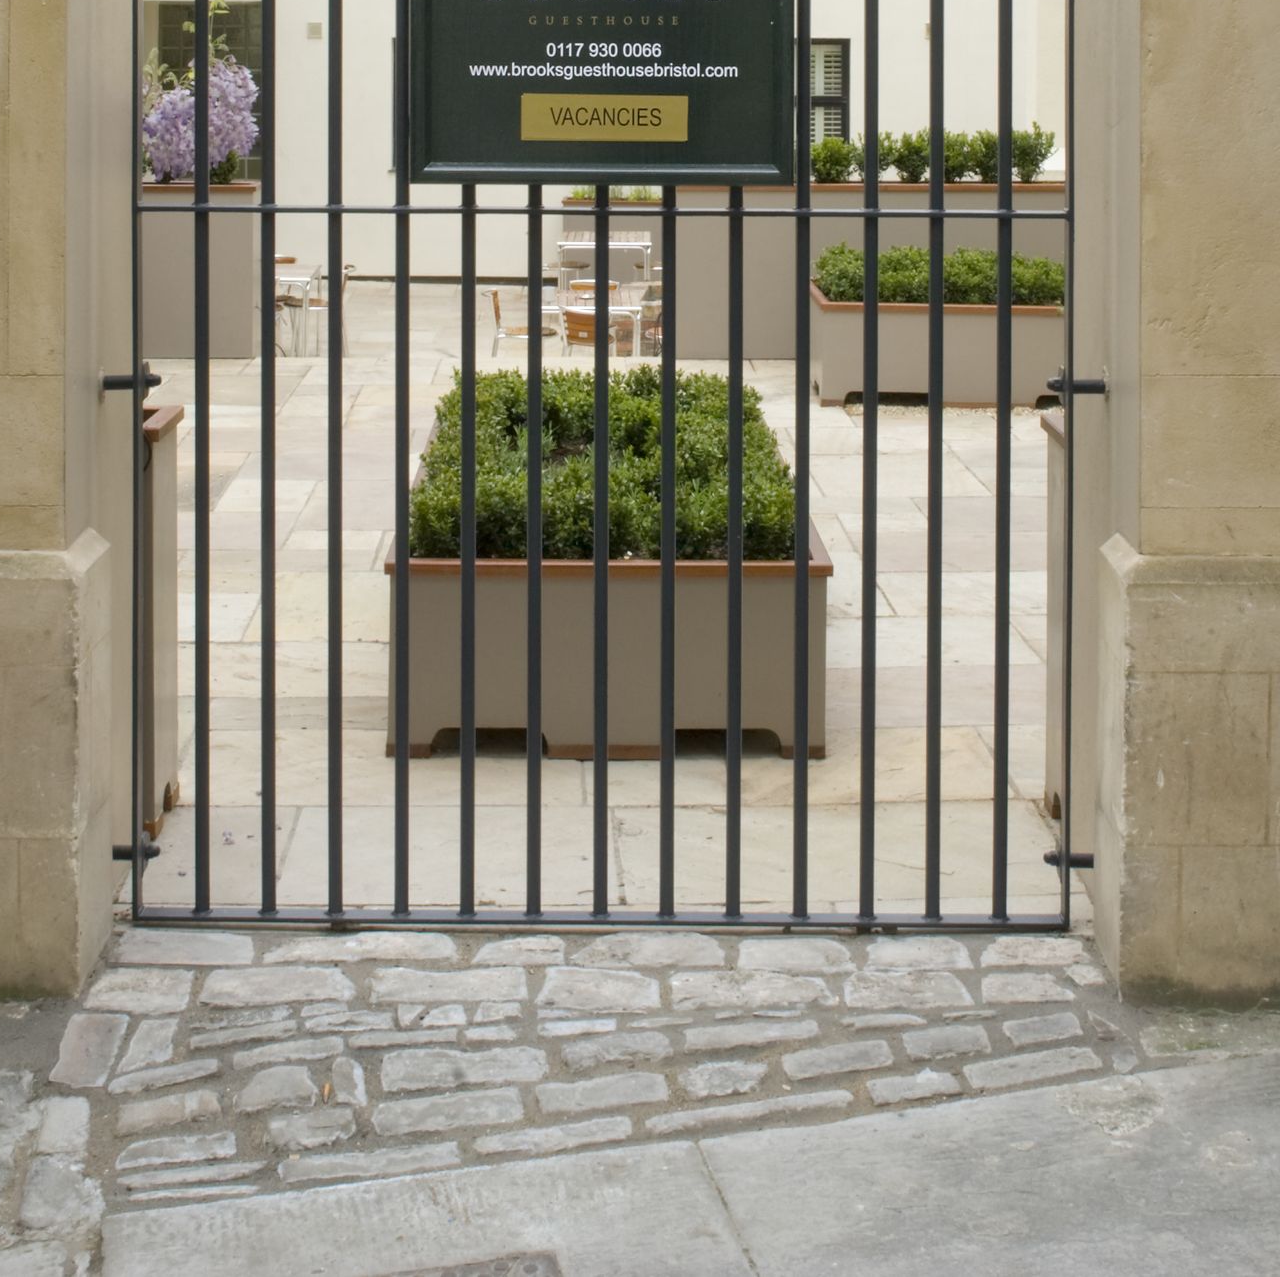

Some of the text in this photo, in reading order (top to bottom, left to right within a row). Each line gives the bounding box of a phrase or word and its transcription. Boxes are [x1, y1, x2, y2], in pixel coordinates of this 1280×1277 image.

[528, 15, 680, 26] GUESTHOUSE
[546, 42, 662, 58] 0117 930 0066
[469, 62, 739, 80] www.brooksguesthousebristol.com
[550, 106, 662, 127] VACANCIES
